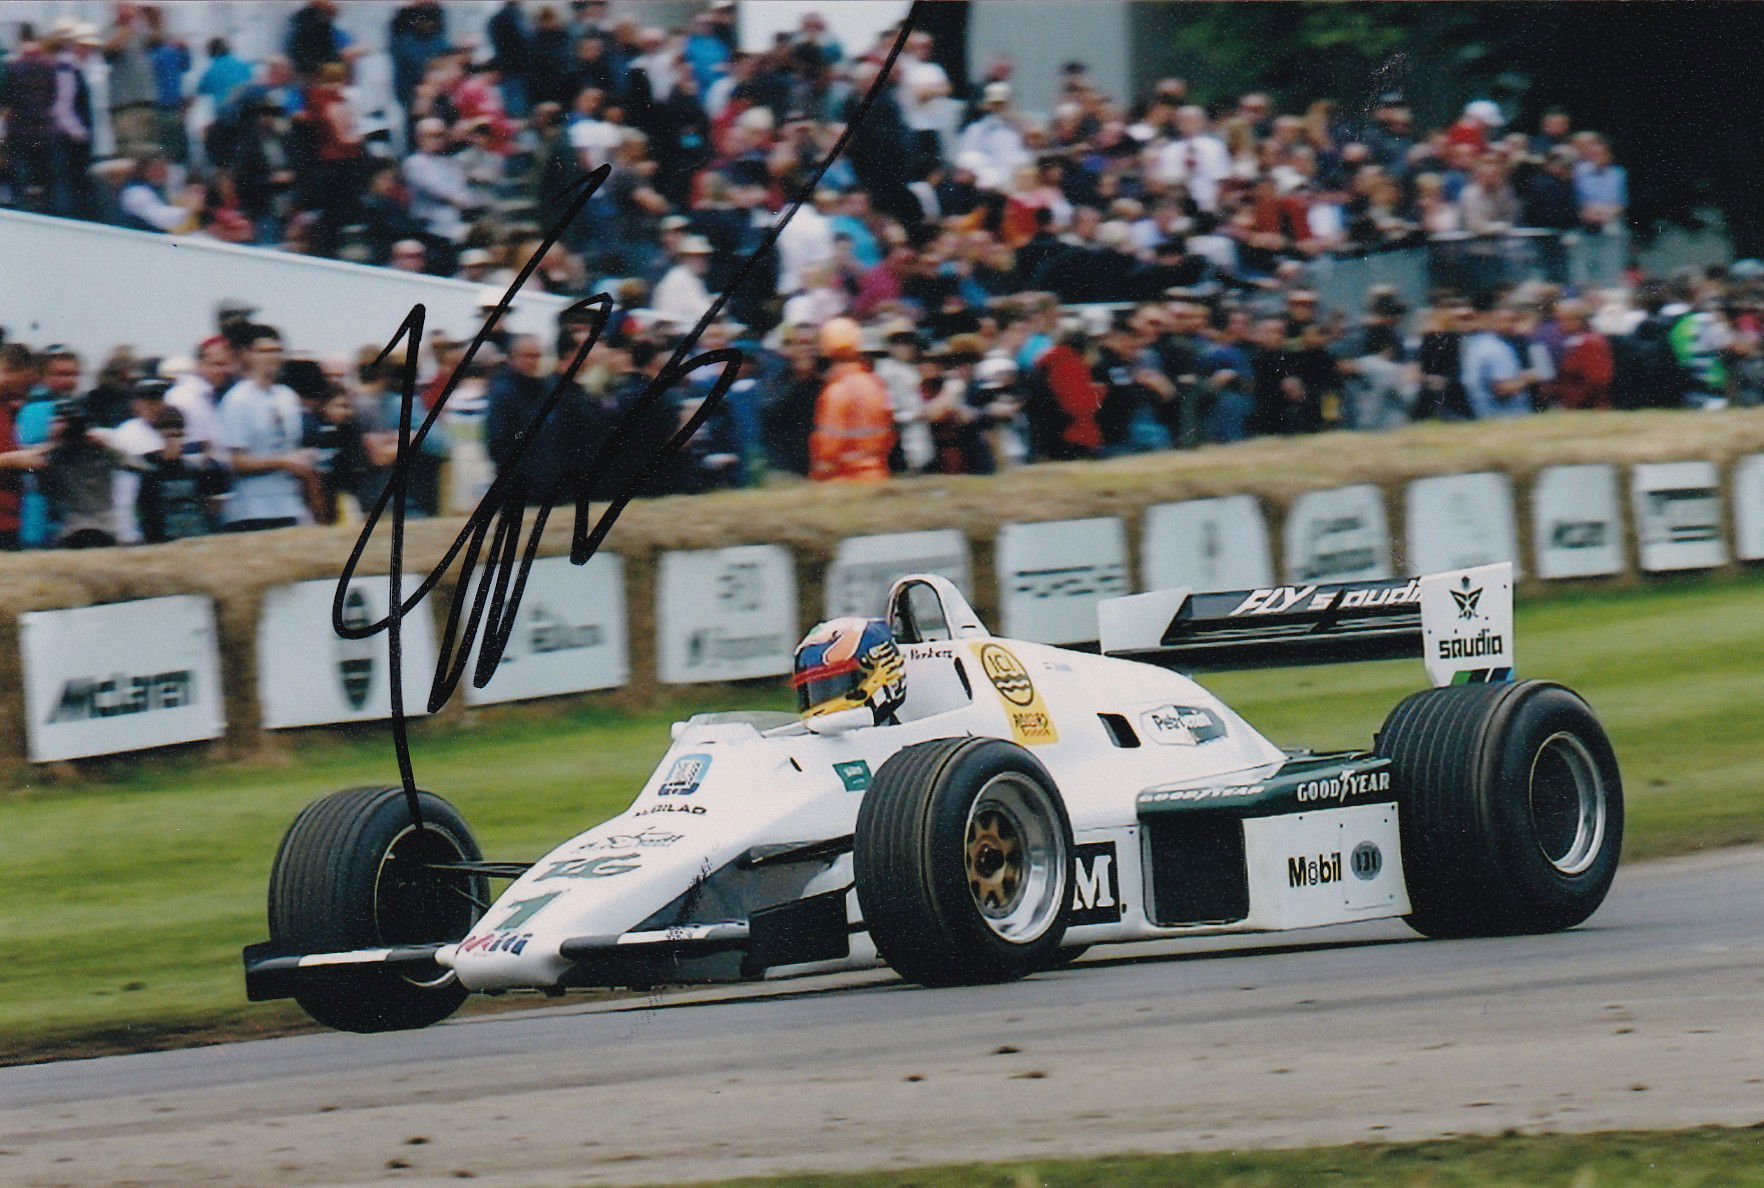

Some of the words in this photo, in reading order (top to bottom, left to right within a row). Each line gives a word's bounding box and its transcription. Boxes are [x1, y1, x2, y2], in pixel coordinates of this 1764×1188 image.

[1229, 585, 1316, 616] FLY
[1439, 629, 1503, 659] saudia
[1296, 769, 1391, 803] GOODYEAR
[1288, 851, 1342, 888] Mobil
[494, 889, 564, 932] 1
